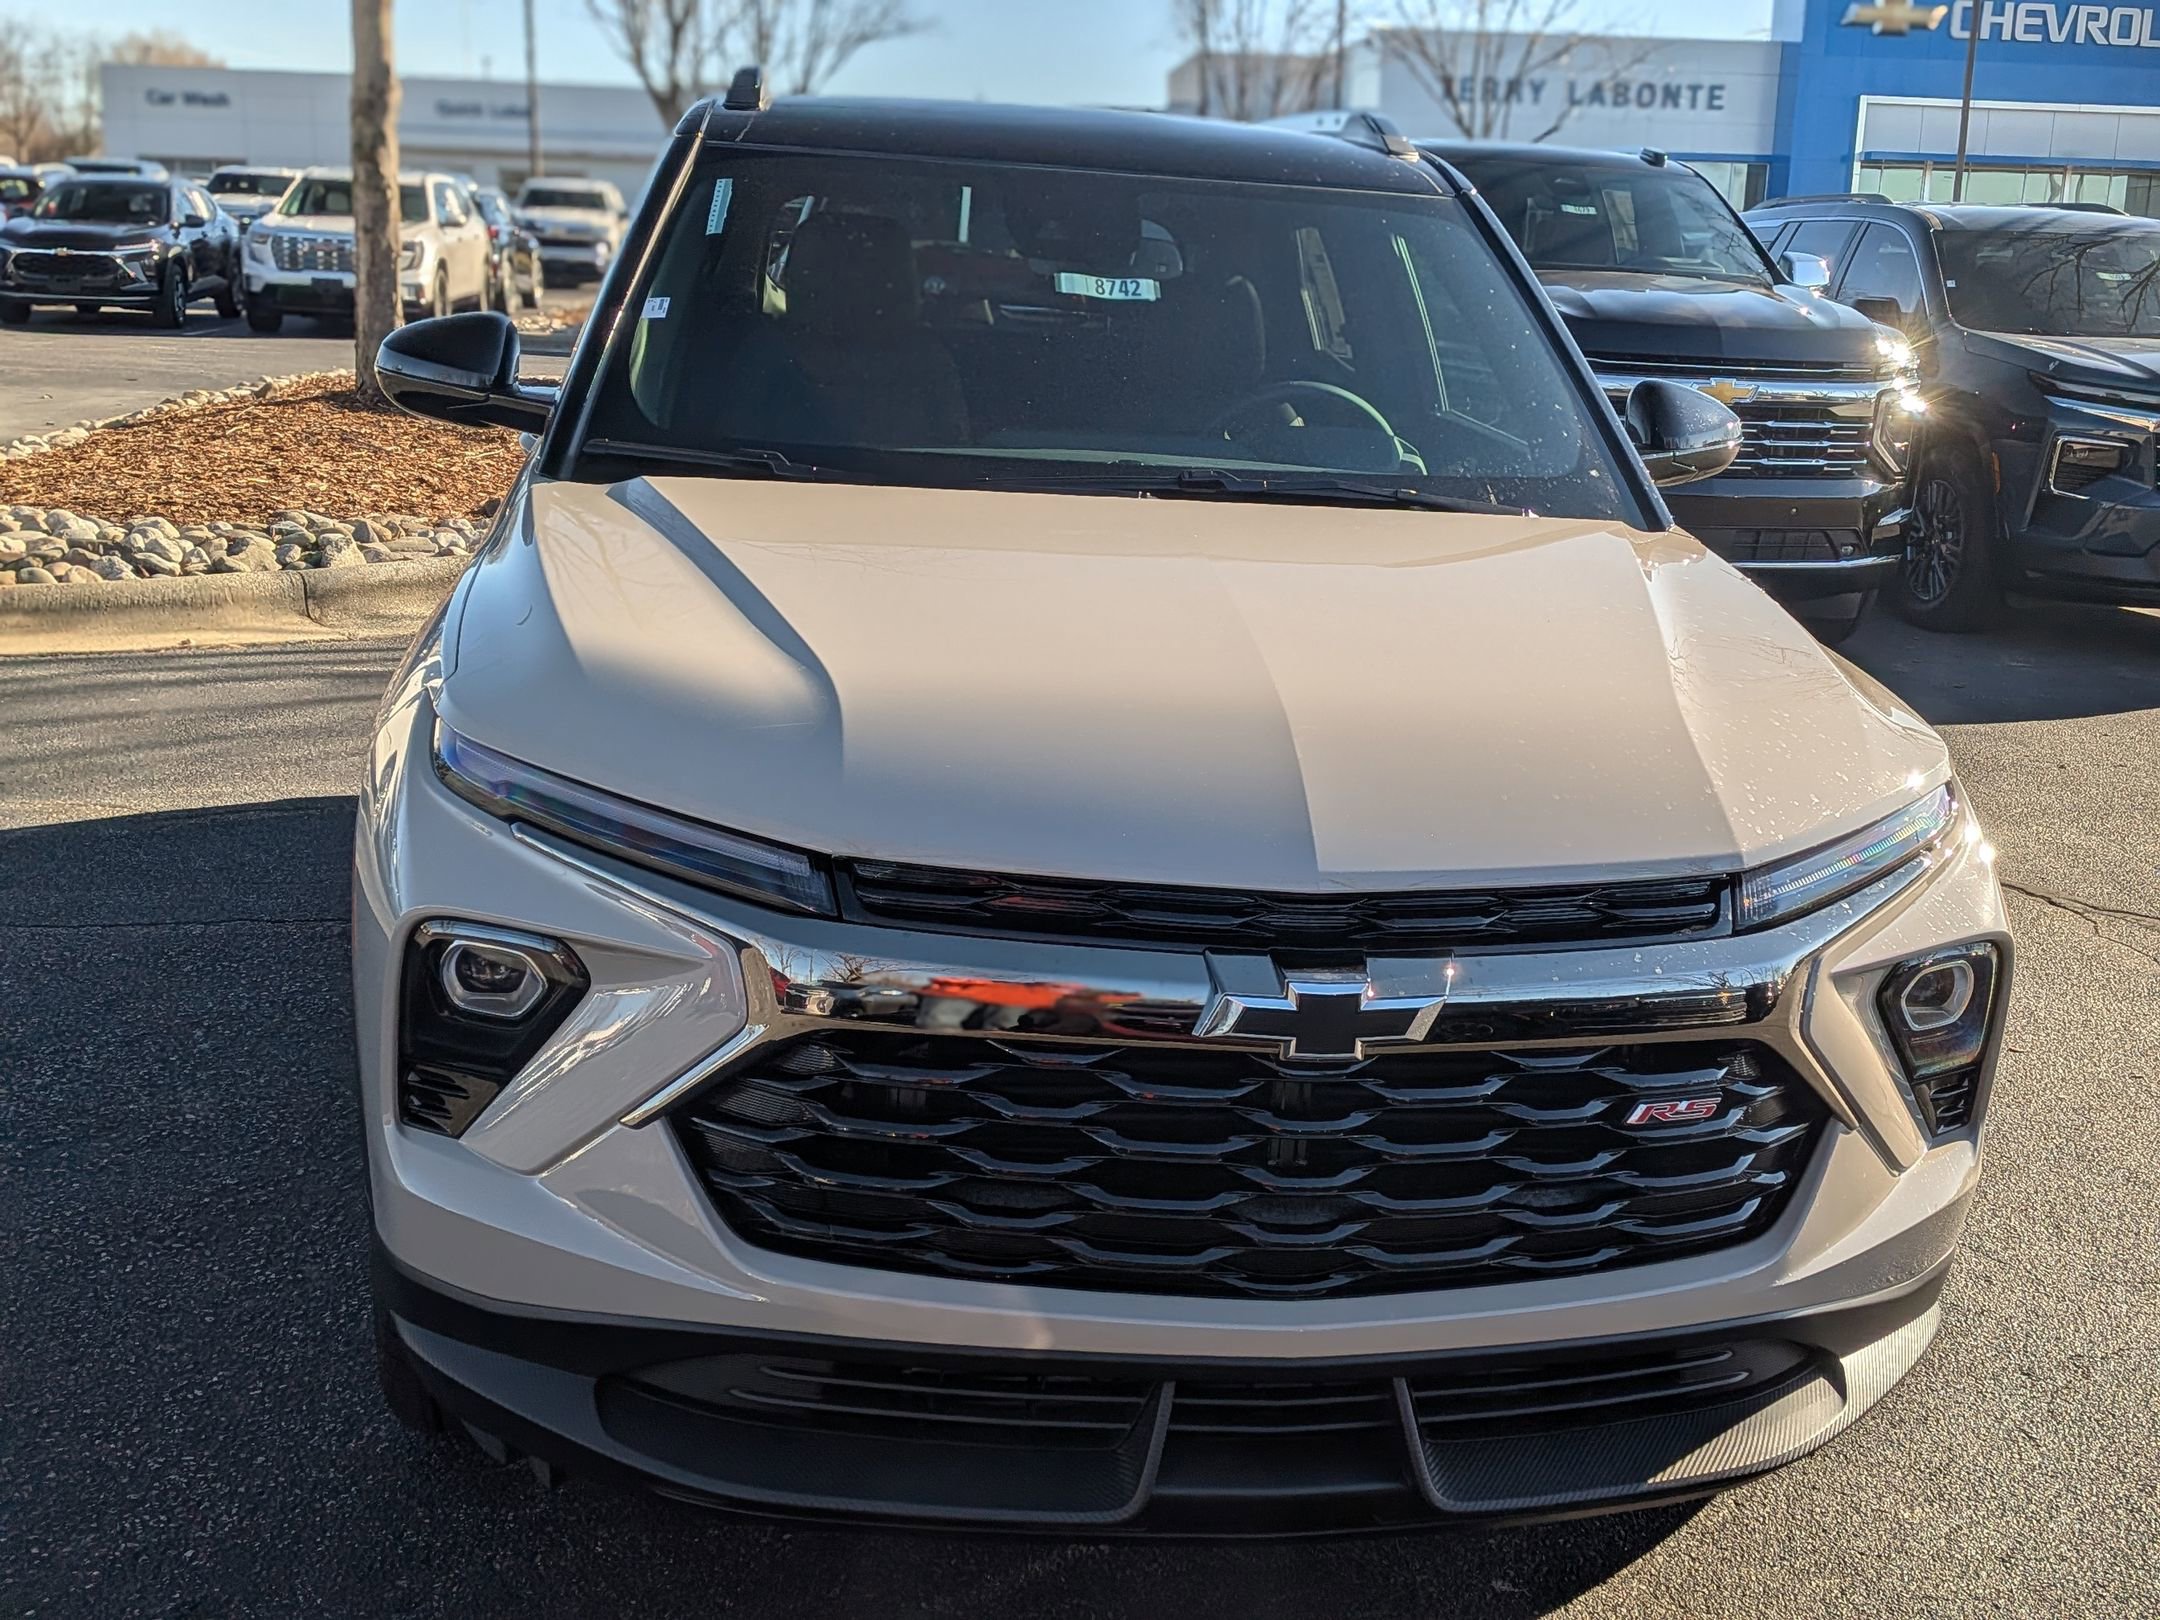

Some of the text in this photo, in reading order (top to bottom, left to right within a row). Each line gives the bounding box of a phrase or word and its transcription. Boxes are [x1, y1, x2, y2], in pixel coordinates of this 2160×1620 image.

[145, 88, 231, 109] Car Wash
[1567, 80, 1726, 111] LABONTE
[1095, 278, 1142, 297] 8742
[1626, 1097, 1722, 1125] RS
